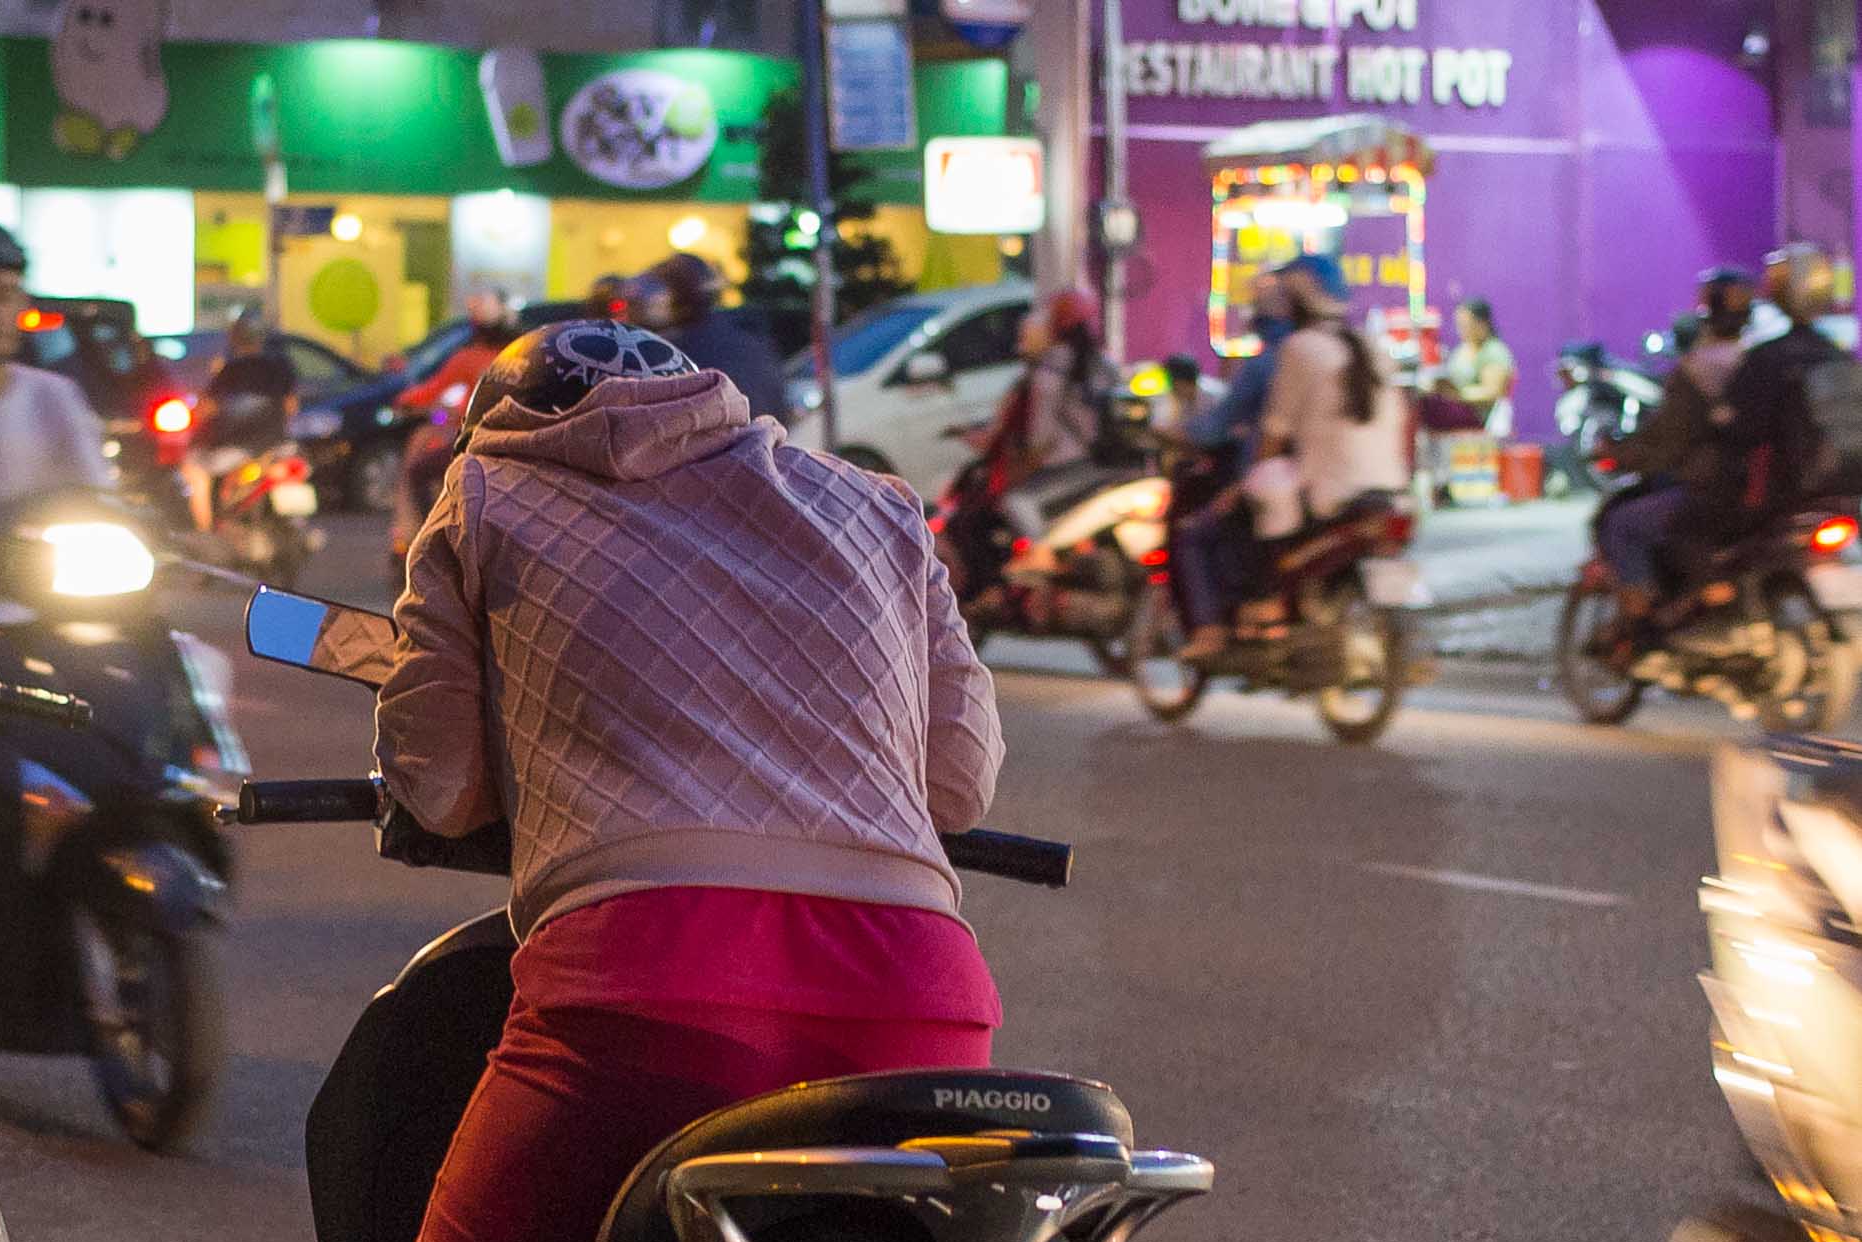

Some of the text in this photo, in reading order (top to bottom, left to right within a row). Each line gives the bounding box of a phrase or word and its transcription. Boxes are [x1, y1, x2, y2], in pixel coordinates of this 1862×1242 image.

[1345, 46, 1426, 105] HOT
[1431, 47, 1512, 107] POT
[933, 1088, 1051, 1112] PIAGGIO
